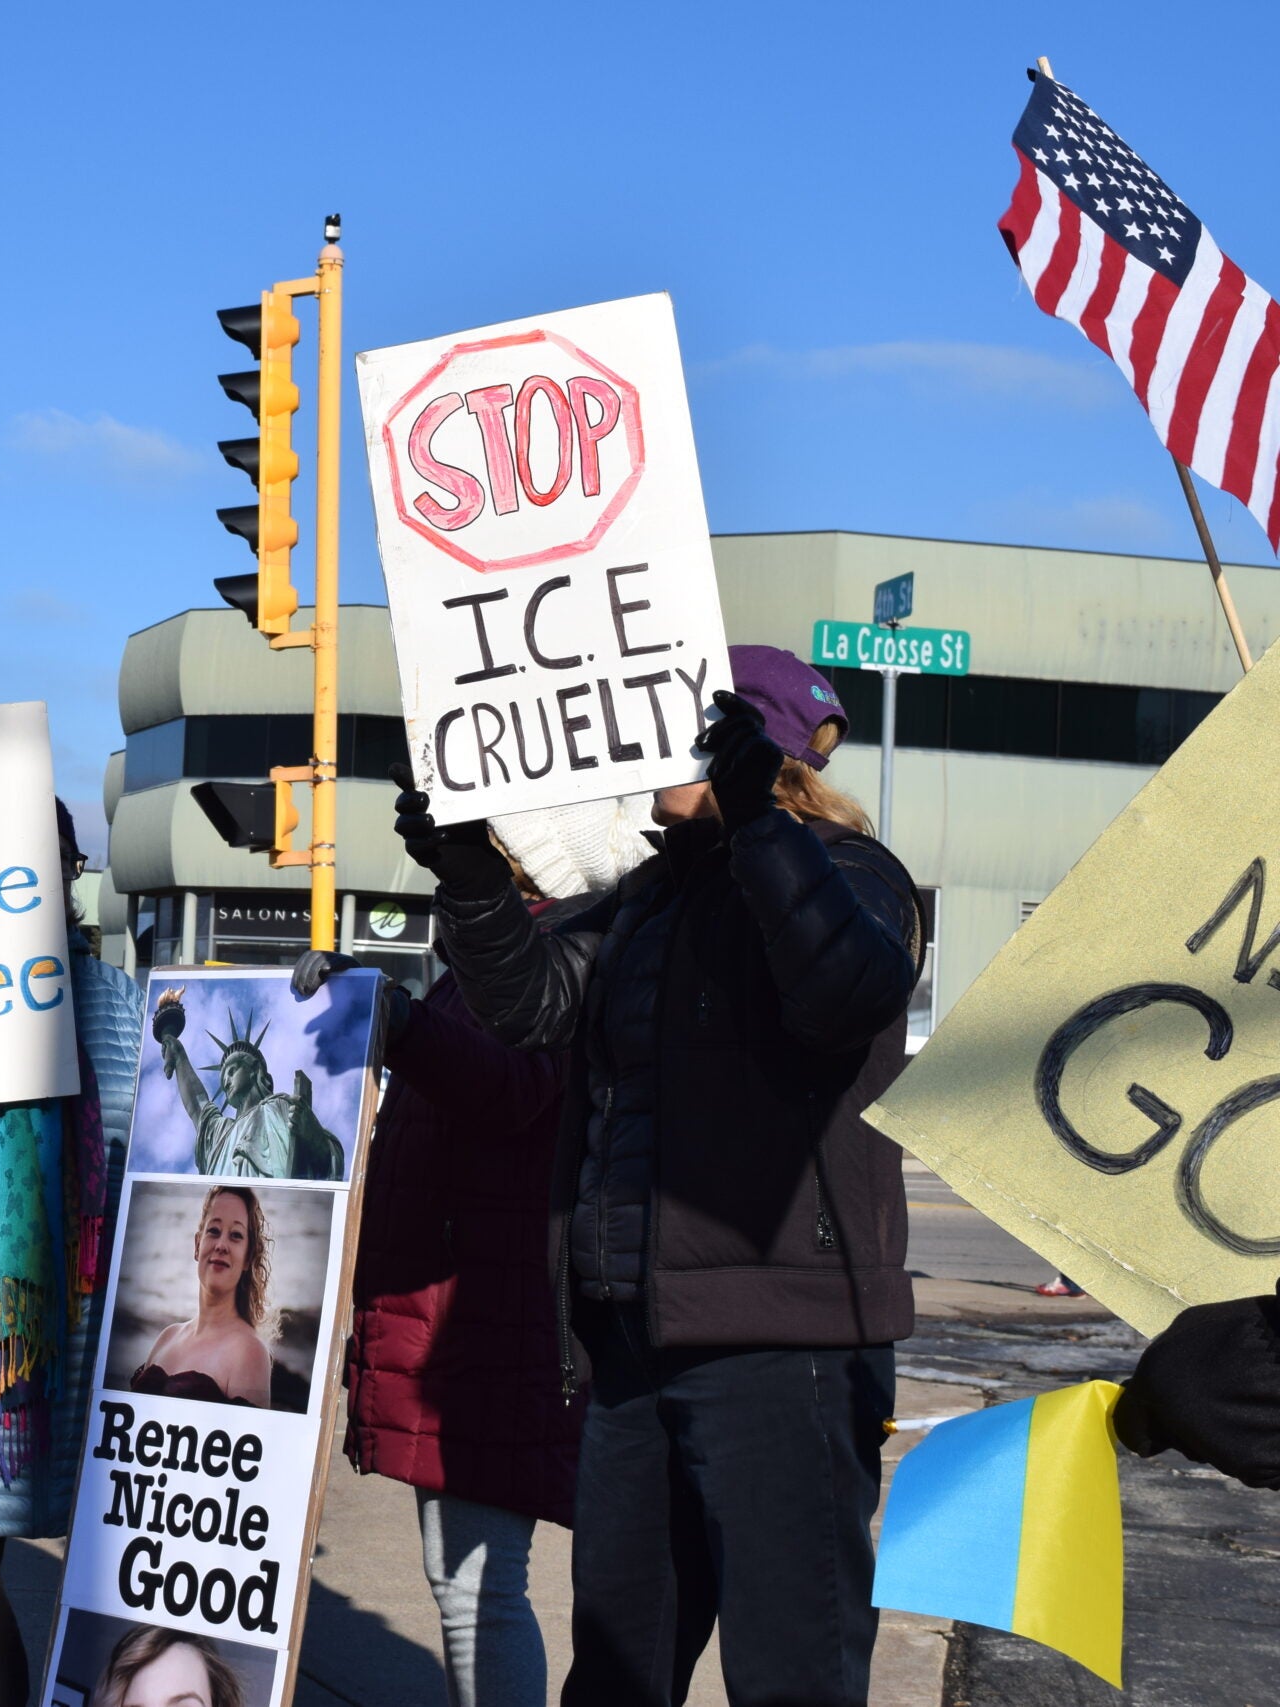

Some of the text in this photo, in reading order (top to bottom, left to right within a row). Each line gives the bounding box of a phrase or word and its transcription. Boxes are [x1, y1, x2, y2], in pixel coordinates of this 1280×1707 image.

[408, 375, 620, 531] STOP
[442, 563, 684, 685] I.C.E.
[822, 624, 964, 669] La Crosse St
[435, 658, 707, 791] CRUELTY
[219, 907, 287, 921] SALON
[93, 1400, 263, 1482] Renee
[103, 1469, 269, 1551] Nicole
[119, 1536, 280, 1635] Good
